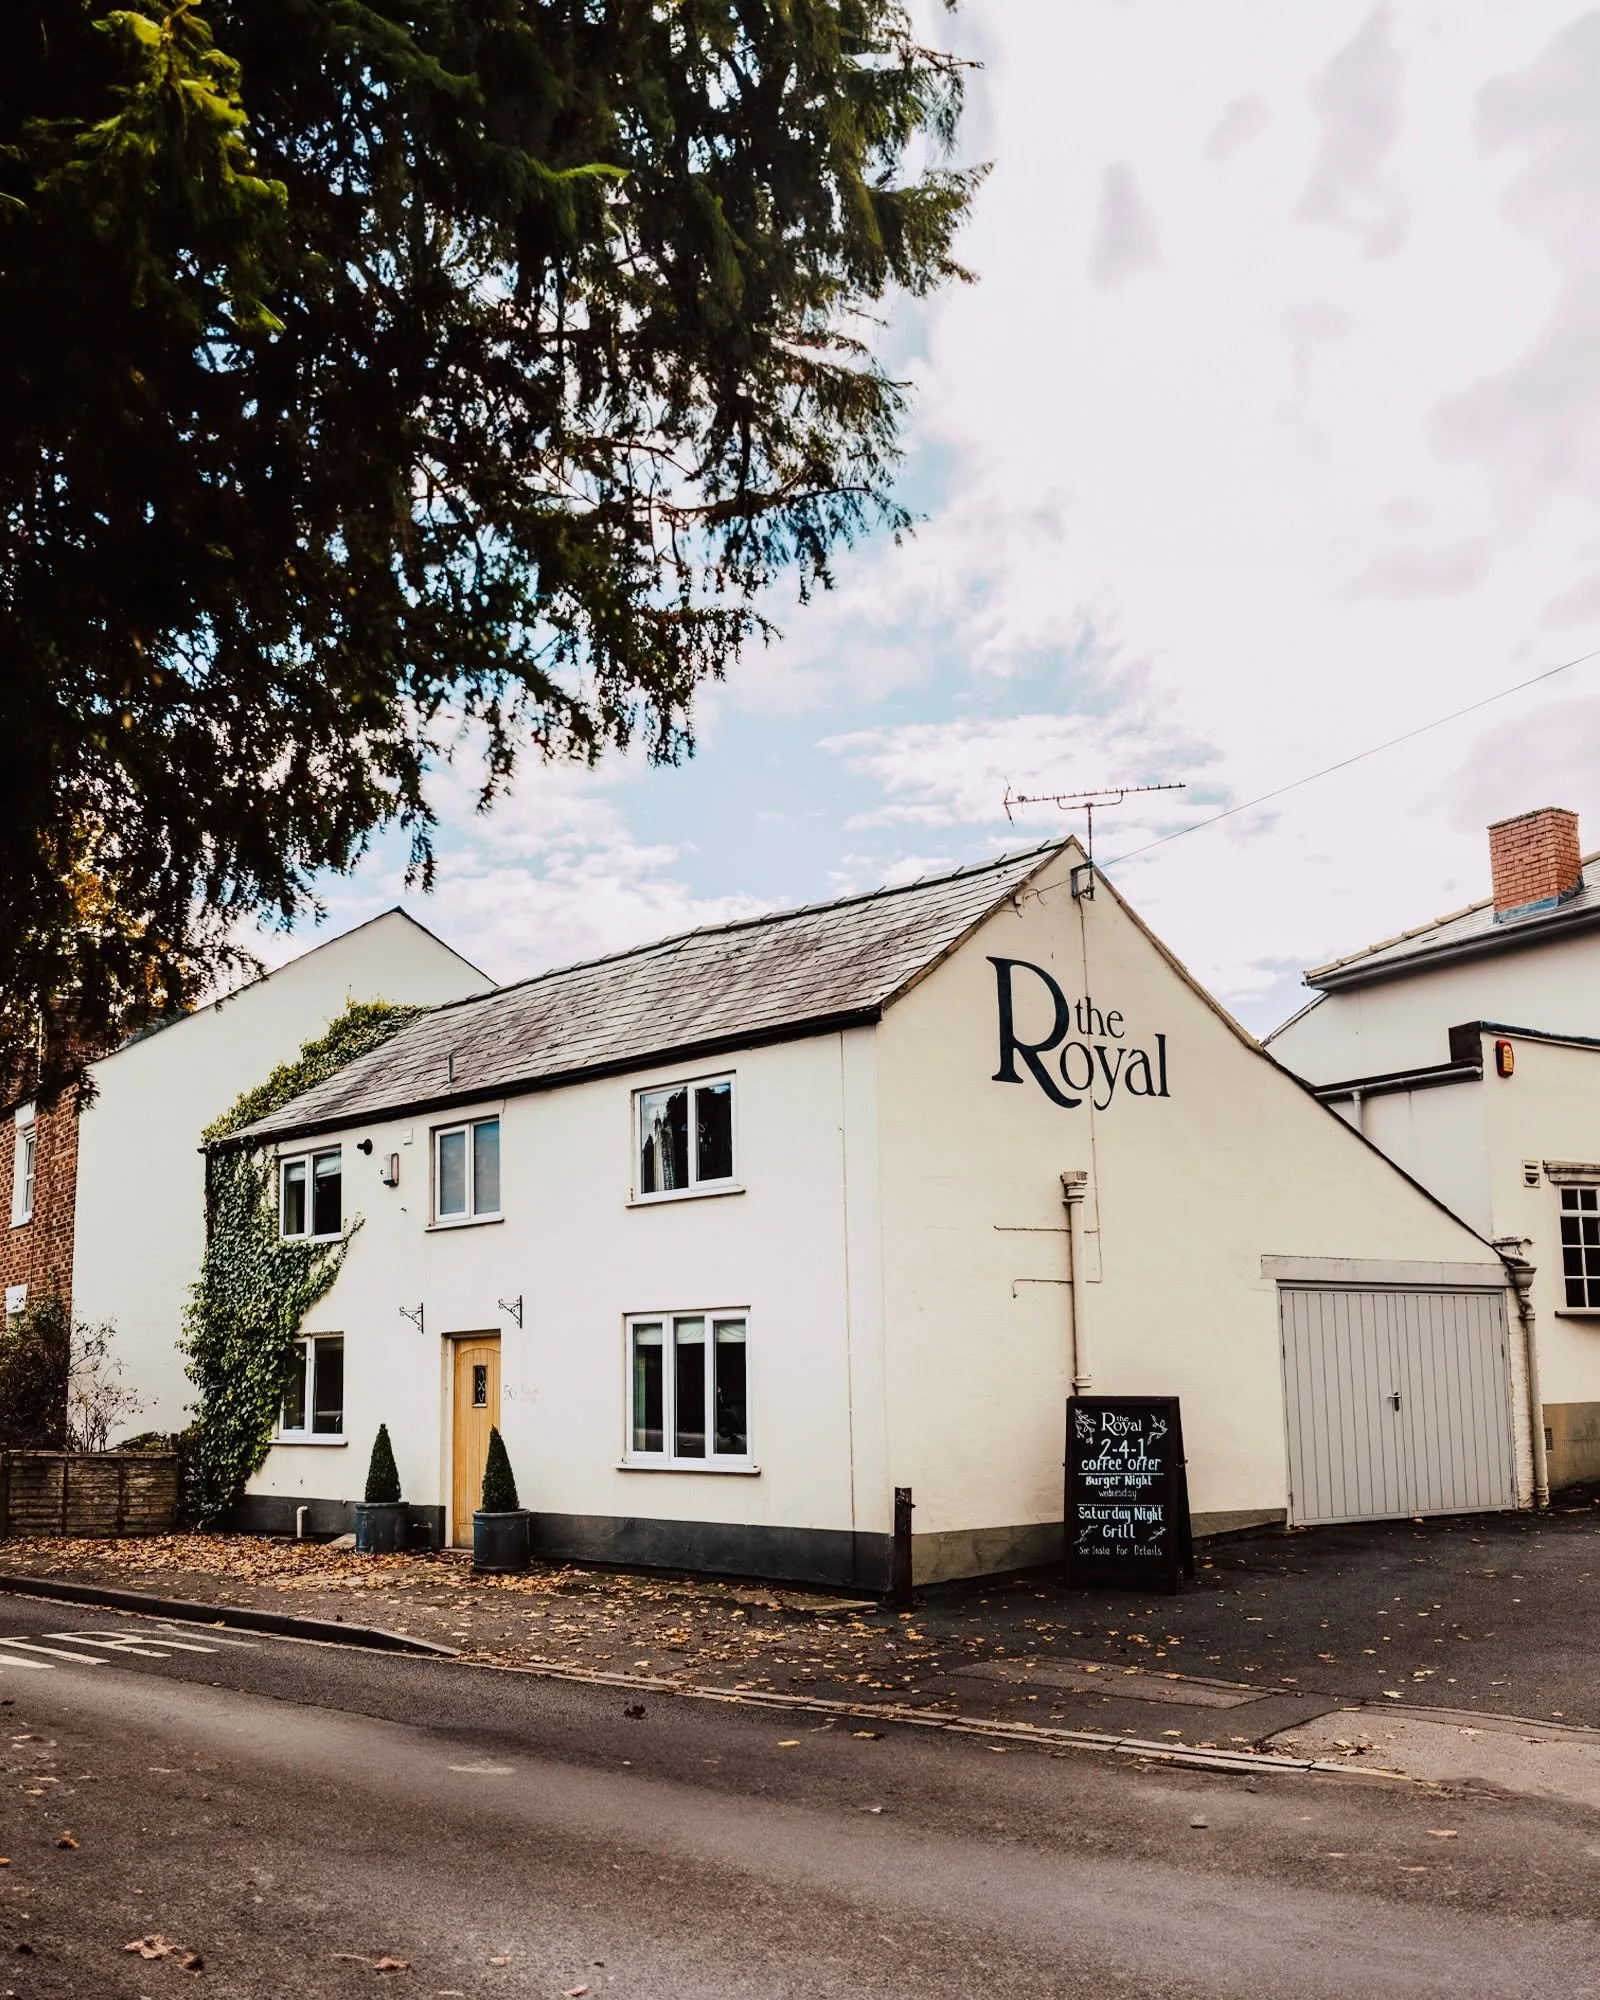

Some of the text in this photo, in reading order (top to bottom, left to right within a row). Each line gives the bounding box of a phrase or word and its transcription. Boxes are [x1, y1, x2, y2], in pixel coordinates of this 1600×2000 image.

[1074, 996, 1126, 1039] the
[985, 955, 1171, 1111] Royal
[1101, 1412, 1142, 1437] Royal
[1098, 1438, 1148, 1460] 2-4-1
[1081, 1458, 1162, 1471] coffee offer
[1085, 1475, 1152, 1489] Burger Night
[1078, 1506, 1164, 1524] Saturday Night
[1102, 1523, 1136, 1539] Grill
[1116, 1544, 1128, 1556] For
[1134, 1544, 1162, 1556] Details
